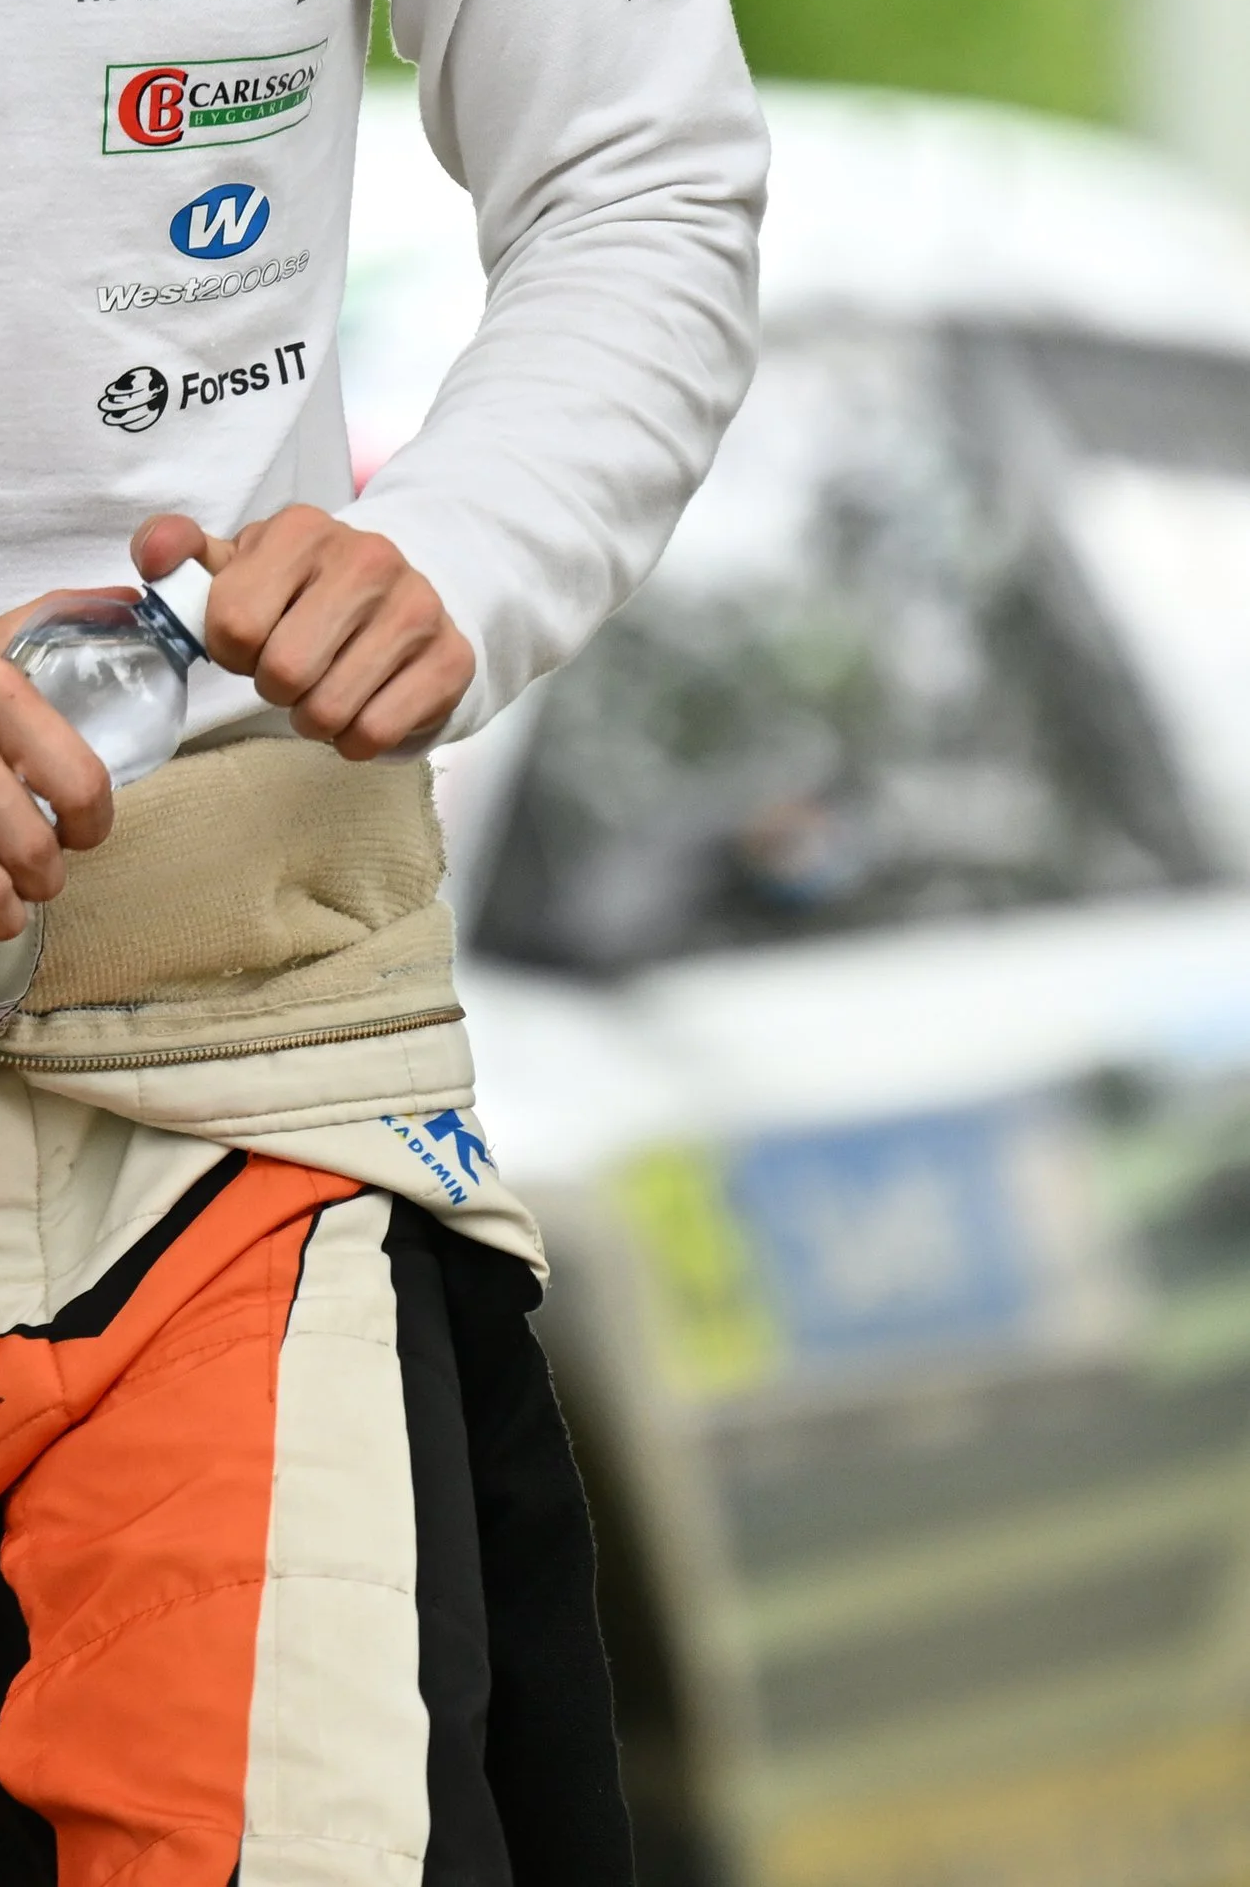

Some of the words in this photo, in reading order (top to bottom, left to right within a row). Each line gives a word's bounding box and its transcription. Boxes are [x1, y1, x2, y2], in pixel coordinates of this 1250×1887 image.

[189, 63, 317, 108] CARLSSON
[97, 250, 310, 313] West2000.se
[179, 361, 270, 410] Forss
[274, 341, 306, 385] IT
